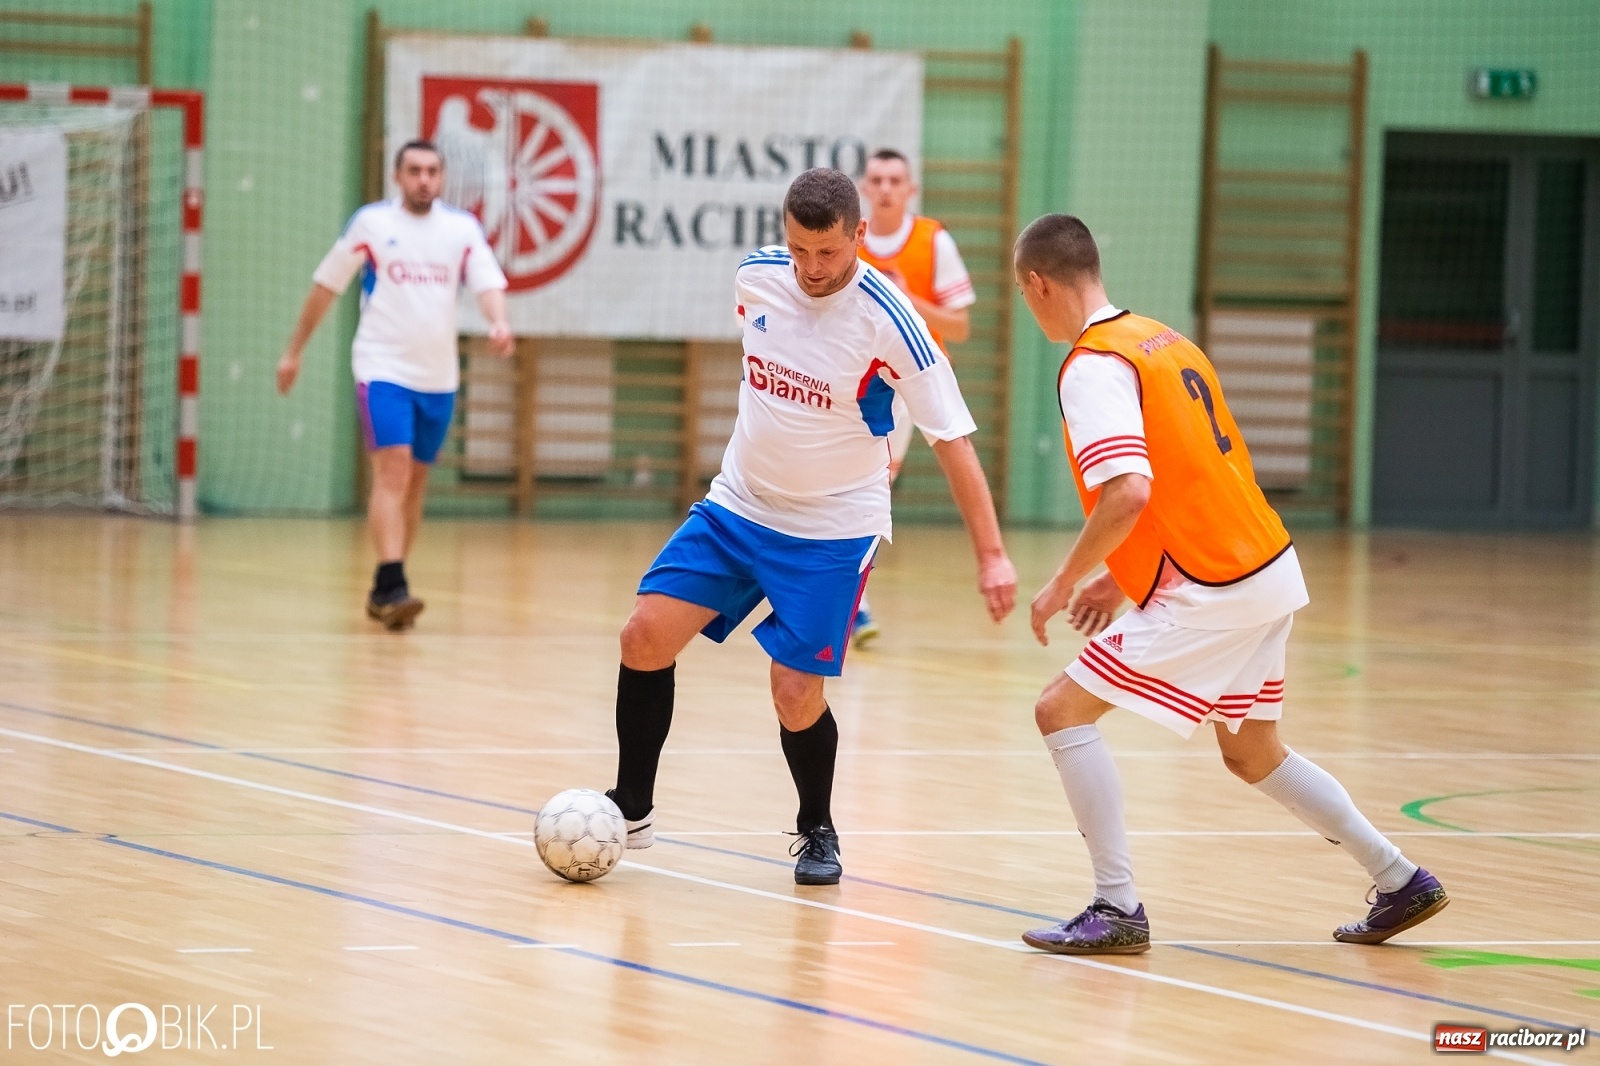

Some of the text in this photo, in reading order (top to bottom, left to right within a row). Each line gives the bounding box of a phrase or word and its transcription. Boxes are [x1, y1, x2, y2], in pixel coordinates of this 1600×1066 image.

[653, 131, 868, 180] MIASTO
[613, 201, 784, 249] RACIB
[747, 355, 832, 410] Gianni
[767, 361, 831, 394] CUKIERNIA
[1180, 368, 1233, 456] 2
[1102, 637, 1124, 654] adidas
